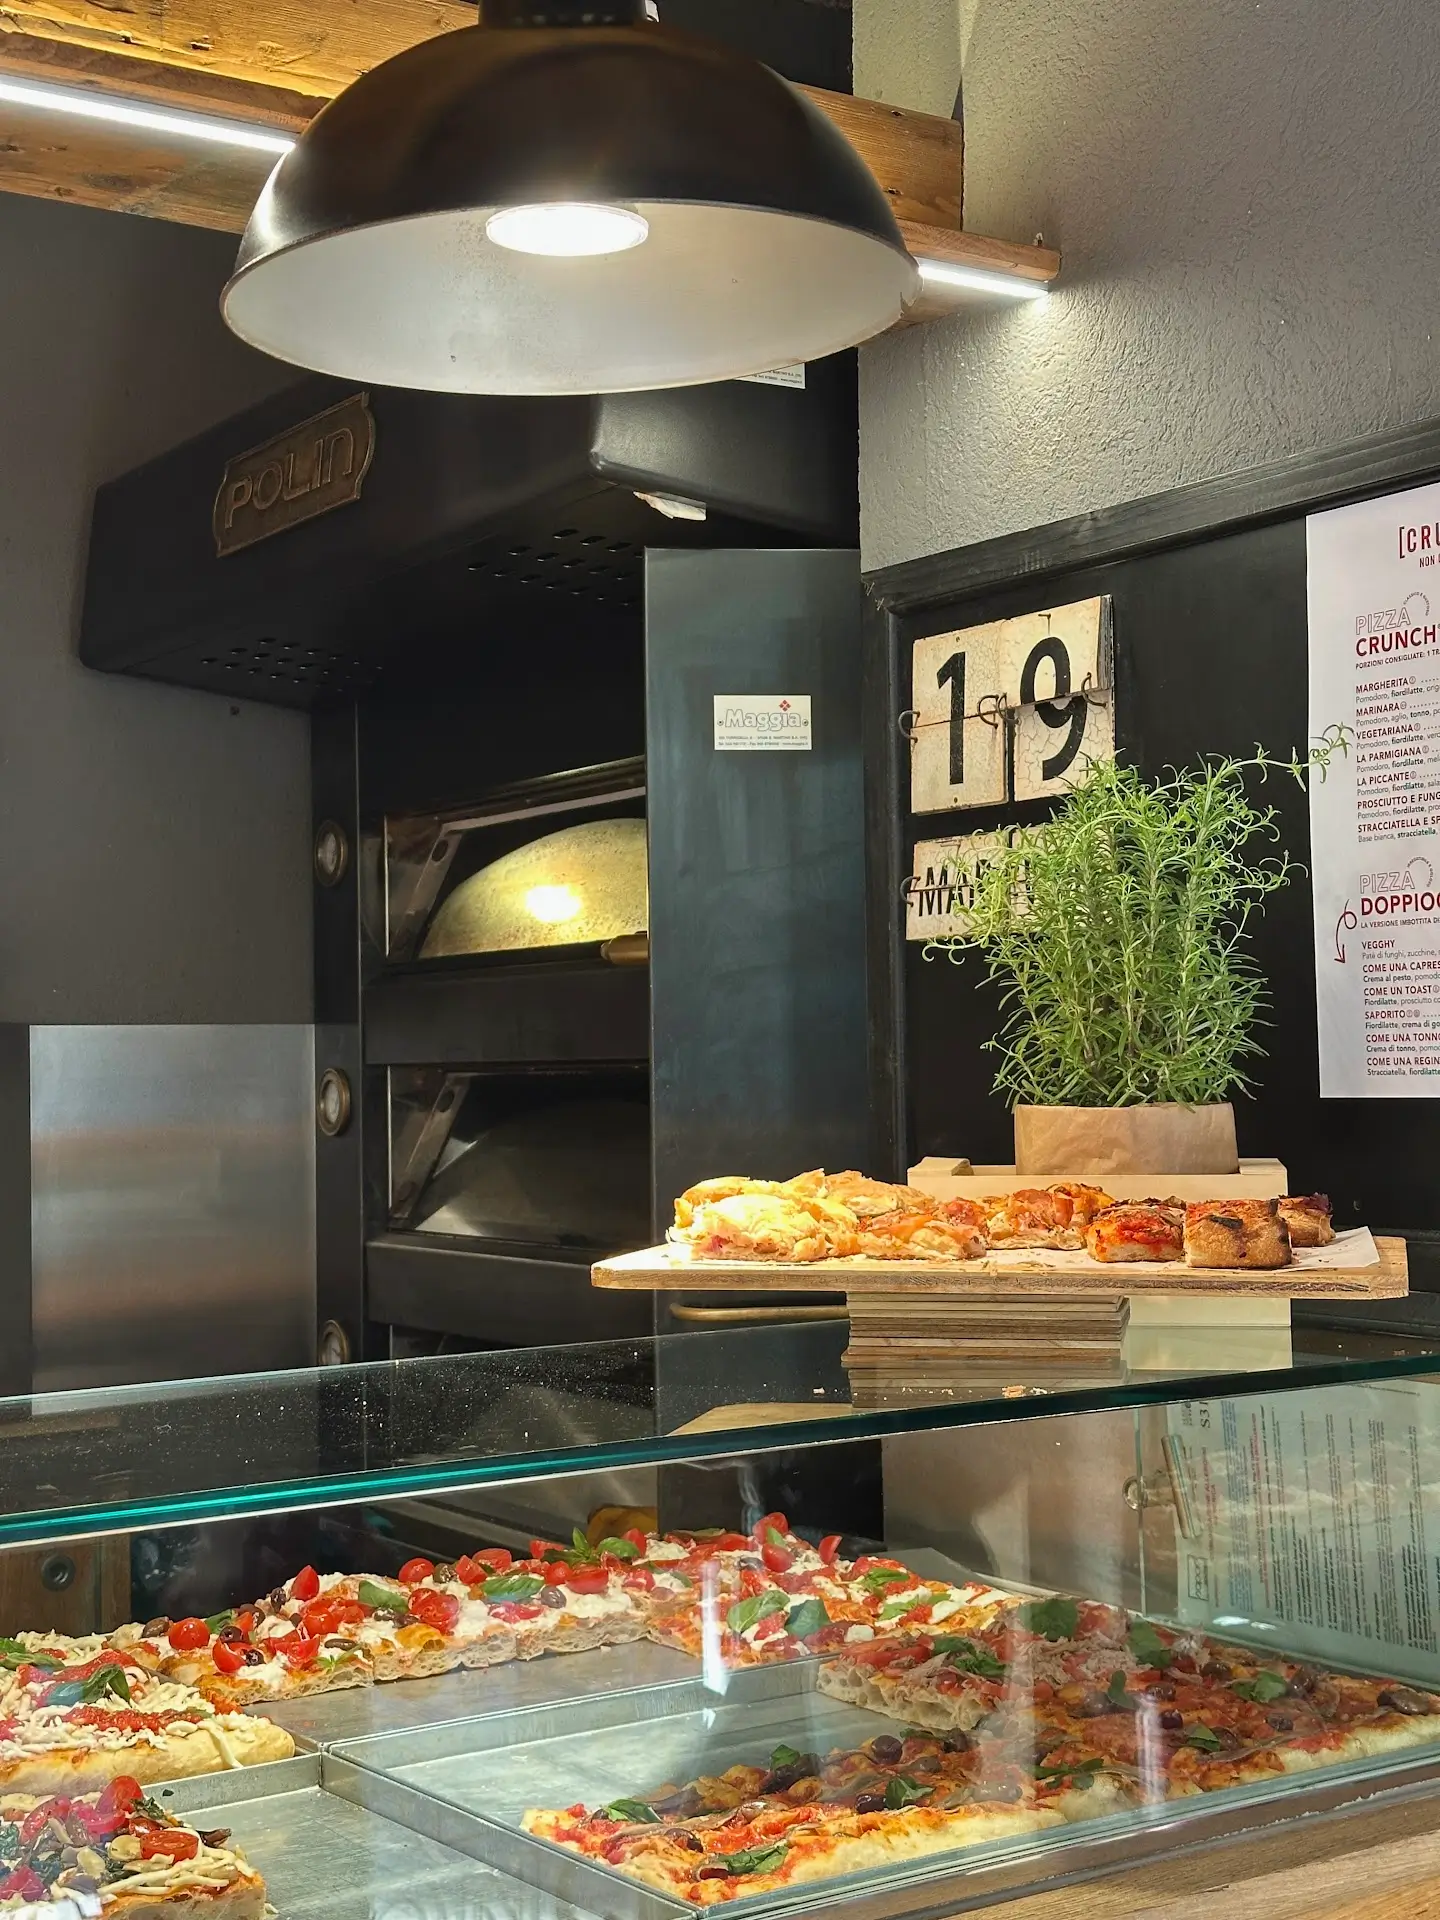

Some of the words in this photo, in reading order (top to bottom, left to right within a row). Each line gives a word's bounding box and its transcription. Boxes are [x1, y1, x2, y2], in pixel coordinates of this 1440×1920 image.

[1420, 555, 1435, 568] NON
[1356, 607, 1411, 635] PIZZA
[1356, 660, 1383, 670] PORZIONI
[1385, 651, 1424, 664] CONSIGLIATE:
[1356, 677, 1408, 694] MARGHERITA
[1356, 693, 1389, 704] Pomodoro,
[1391, 687, 1424, 697] fiordilatte,
[1356, 703, 1400, 717] MARINARA
[725, 708, 801, 732] Maggia
[1356, 716, 1389, 727] Pomodoro,
[1391, 714, 1408, 723] aglio,
[1410, 709, 1431, 718] tonno,
[1356, 724, 1413, 740] VEGETARIANA
[1357, 739, 1390, 750] Pomodoro,
[1391, 735, 1425, 744] fiordilatte,
[1356, 754, 1366, 764] LA
[1369, 746, 1421, 762] PARMIGIANA
[1357, 762, 1390, 773] Pomodoro,
[1392, 758, 1425, 768] fiordilatte,
[1357, 778, 1366, 787] LA
[1369, 771, 1409, 785] PICCANTE
[1357, 786, 1390, 797] Pomodoro,
[1392, 782, 1426, 792] fiordilatte,
[1357, 795, 1407, 809] PROSCIUTTO
[1411, 794, 1415, 803] E
[1418, 791, 1440, 802] FUNG
[1358, 809, 1391, 819] Pomodoro,
[1393, 806, 1426, 815] fiordilatte,
[1358, 818, 1420, 833] STRACCIATELLA
[1423, 816, 1428, 825] E
[1358, 835, 1373, 843] Base
[1374, 832, 1396, 841] bianca,
[1397, 827, 1438, 839] stracciatella,
[1360, 870, 1415, 894] PIZZA
[1370, 919, 1398, 928] VERSIONE
[1400, 917, 1431, 926] IMBOTTITA
[1361, 939, 1395, 950] VEGGHY
[1377, 950, 1383, 958] di
[1385, 948, 1406, 959] funghi,
[1407, 947, 1437, 957] zucchine,
[1363, 963, 1386, 973] COME
[1390, 962, 1407, 971] UNA
[1363, 975, 1384, 983] Crema
[1386, 973, 1391, 981] al
[1364, 987, 1388, 996] COME
[1391, 986, 1402, 995] UN
[1405, 984, 1432, 995] TOAST
[1400, 996, 1432, 1006] prosciutto
[1365, 1009, 1405, 1020] SAPORITO
[1424, 1019, 1430, 1028] di
[1366, 1034, 1389, 1043] COME
[1392, 1033, 1411, 1042] UNA
[1388, 1044, 1394, 1052] di
[1396, 1045, 1417, 1053] tonno,
[1367, 1057, 1390, 1066] COME
[1393, 1057, 1411, 1066] UNA
[1367, 1068, 1407, 1076] Stracciatella,
